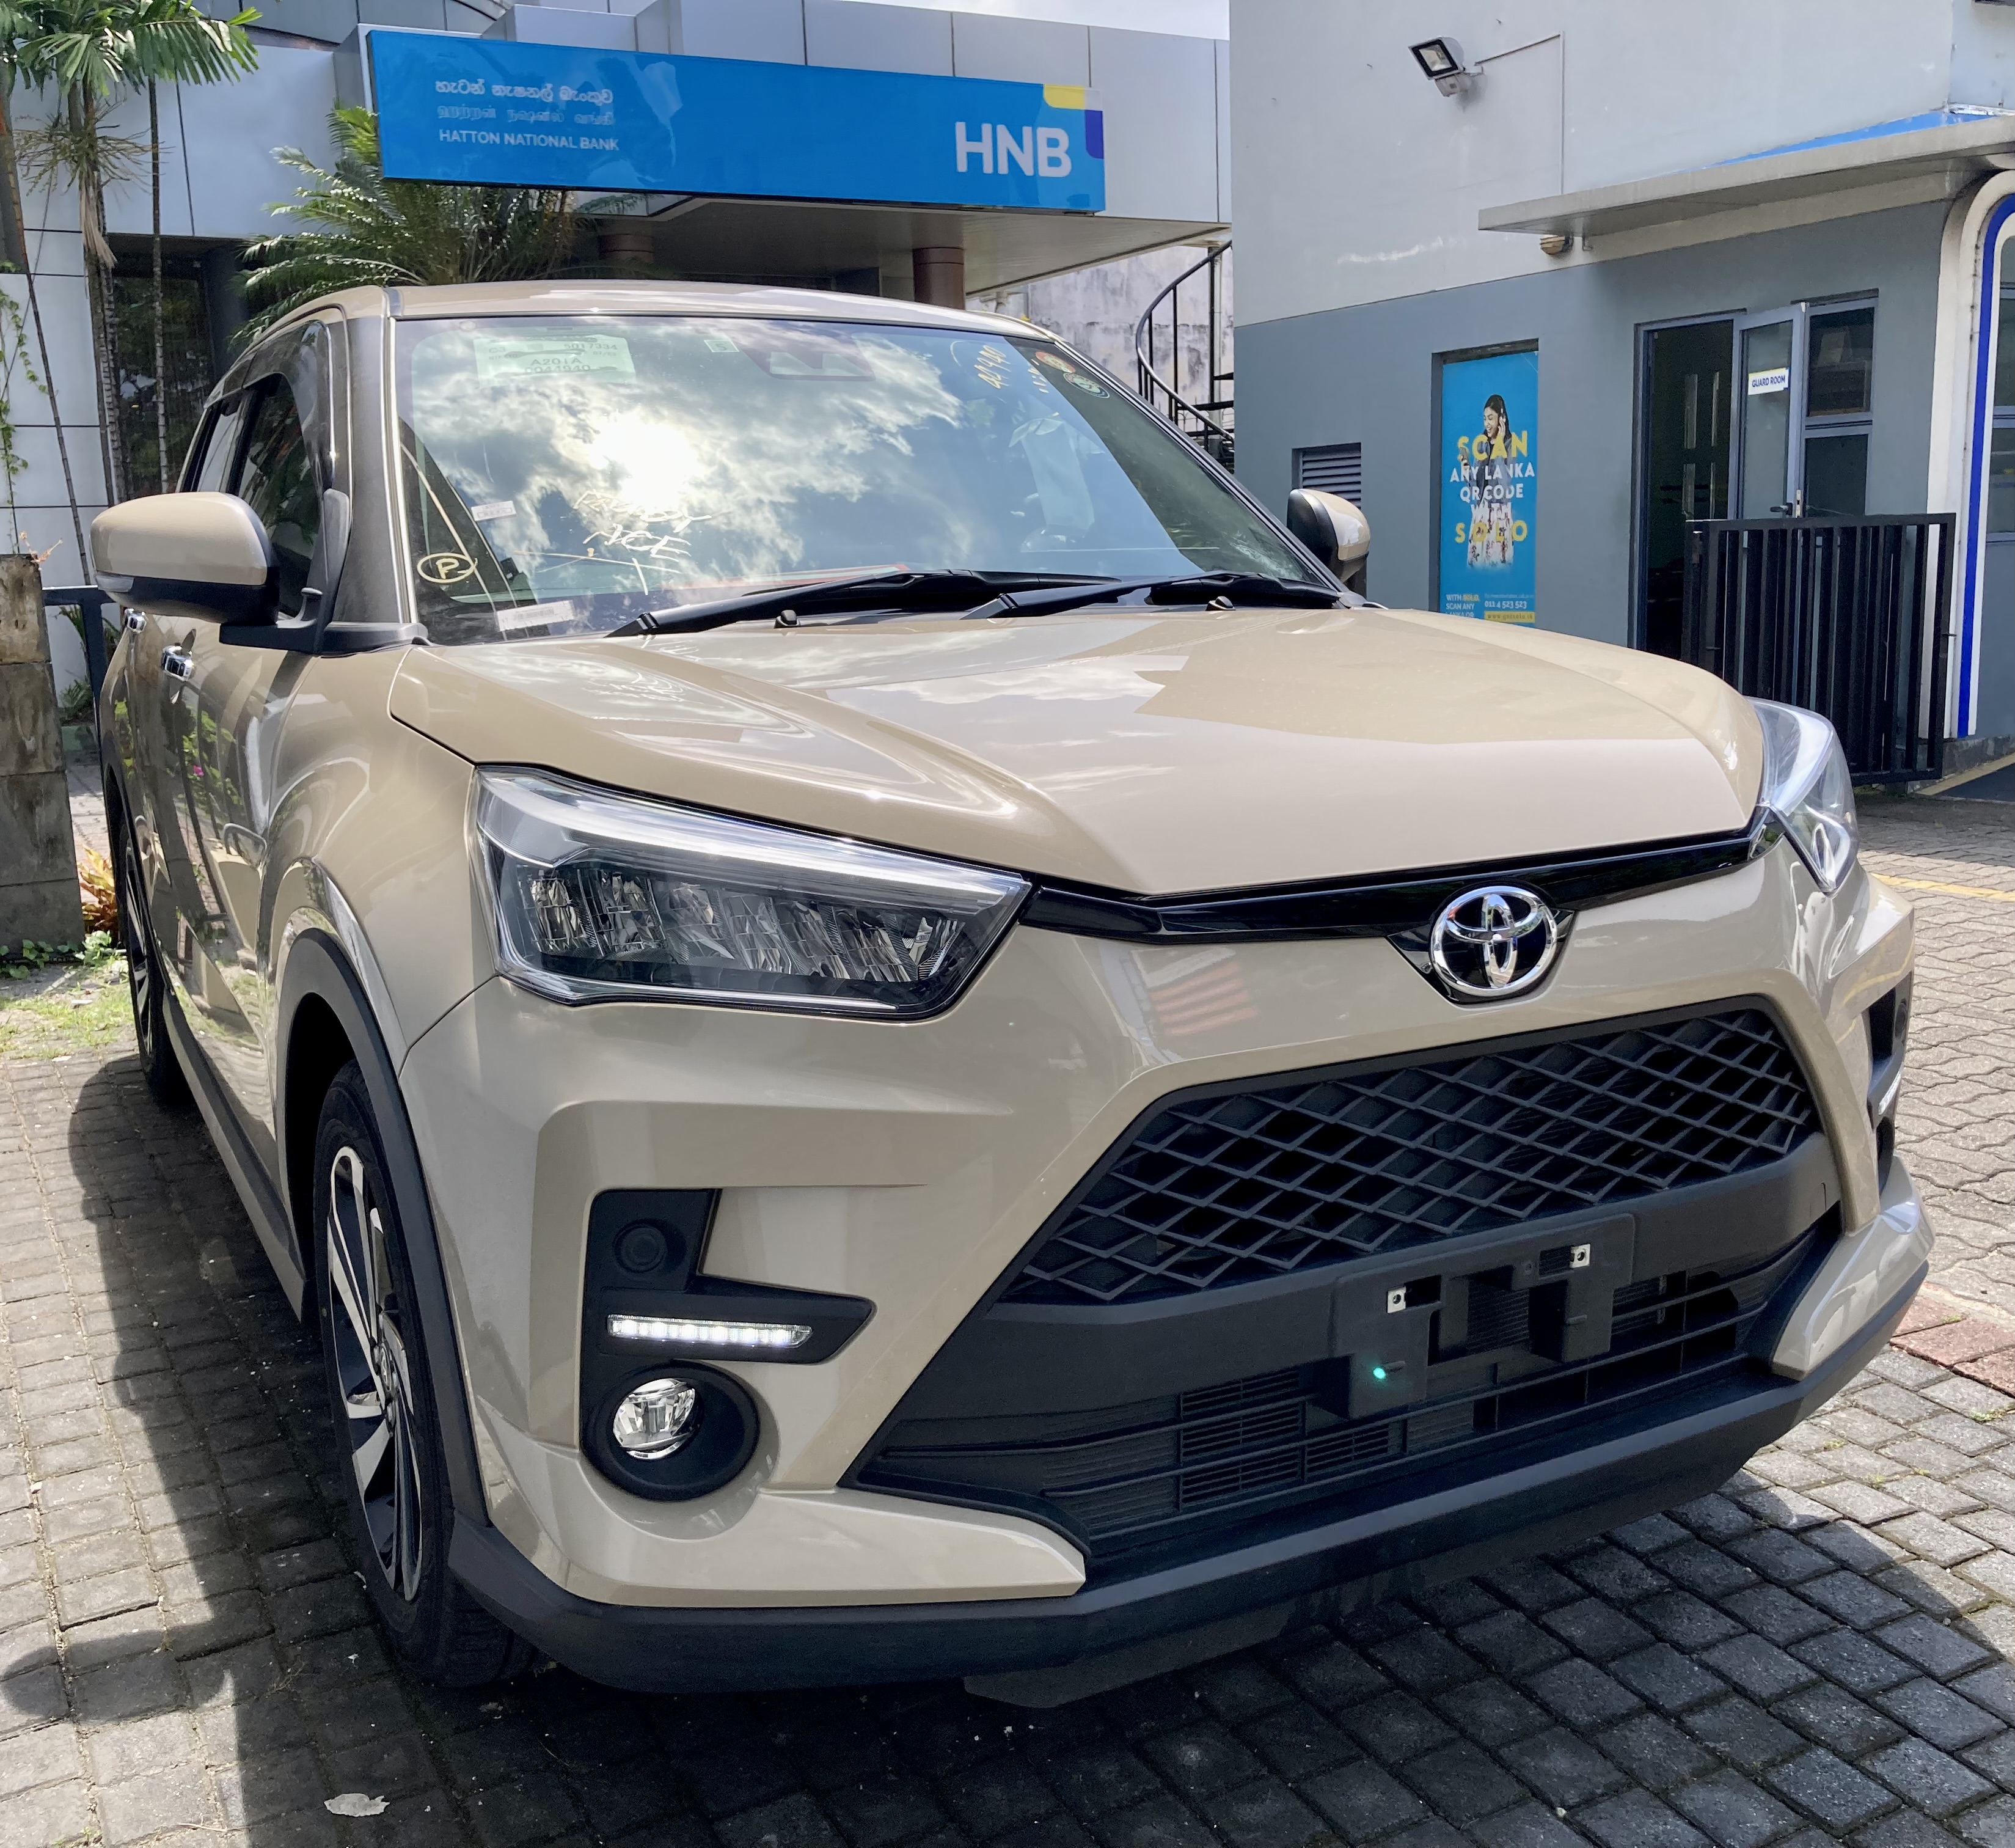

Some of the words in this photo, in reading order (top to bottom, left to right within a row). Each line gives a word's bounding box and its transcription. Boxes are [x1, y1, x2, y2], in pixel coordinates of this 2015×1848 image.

[439, 128, 501, 145] HATTON
[503, 132, 578, 149] NATIONAL
[579, 136, 620, 151] BANK
[954, 121, 1072, 178] HNB
[1752, 378, 1769, 387] GUARD
[1770, 375, 1785, 385] ROOM
[1458, 430, 1527, 461] SCAN
[1450, 465, 1479, 483] ANY
[1485, 461, 1535, 480] LANKA
[1460, 486, 1481, 504] QR
[1483, 483, 1524, 501] CODE
[1454, 519, 1528, 543] SOLO
[1502, 601, 1514, 609] 523
